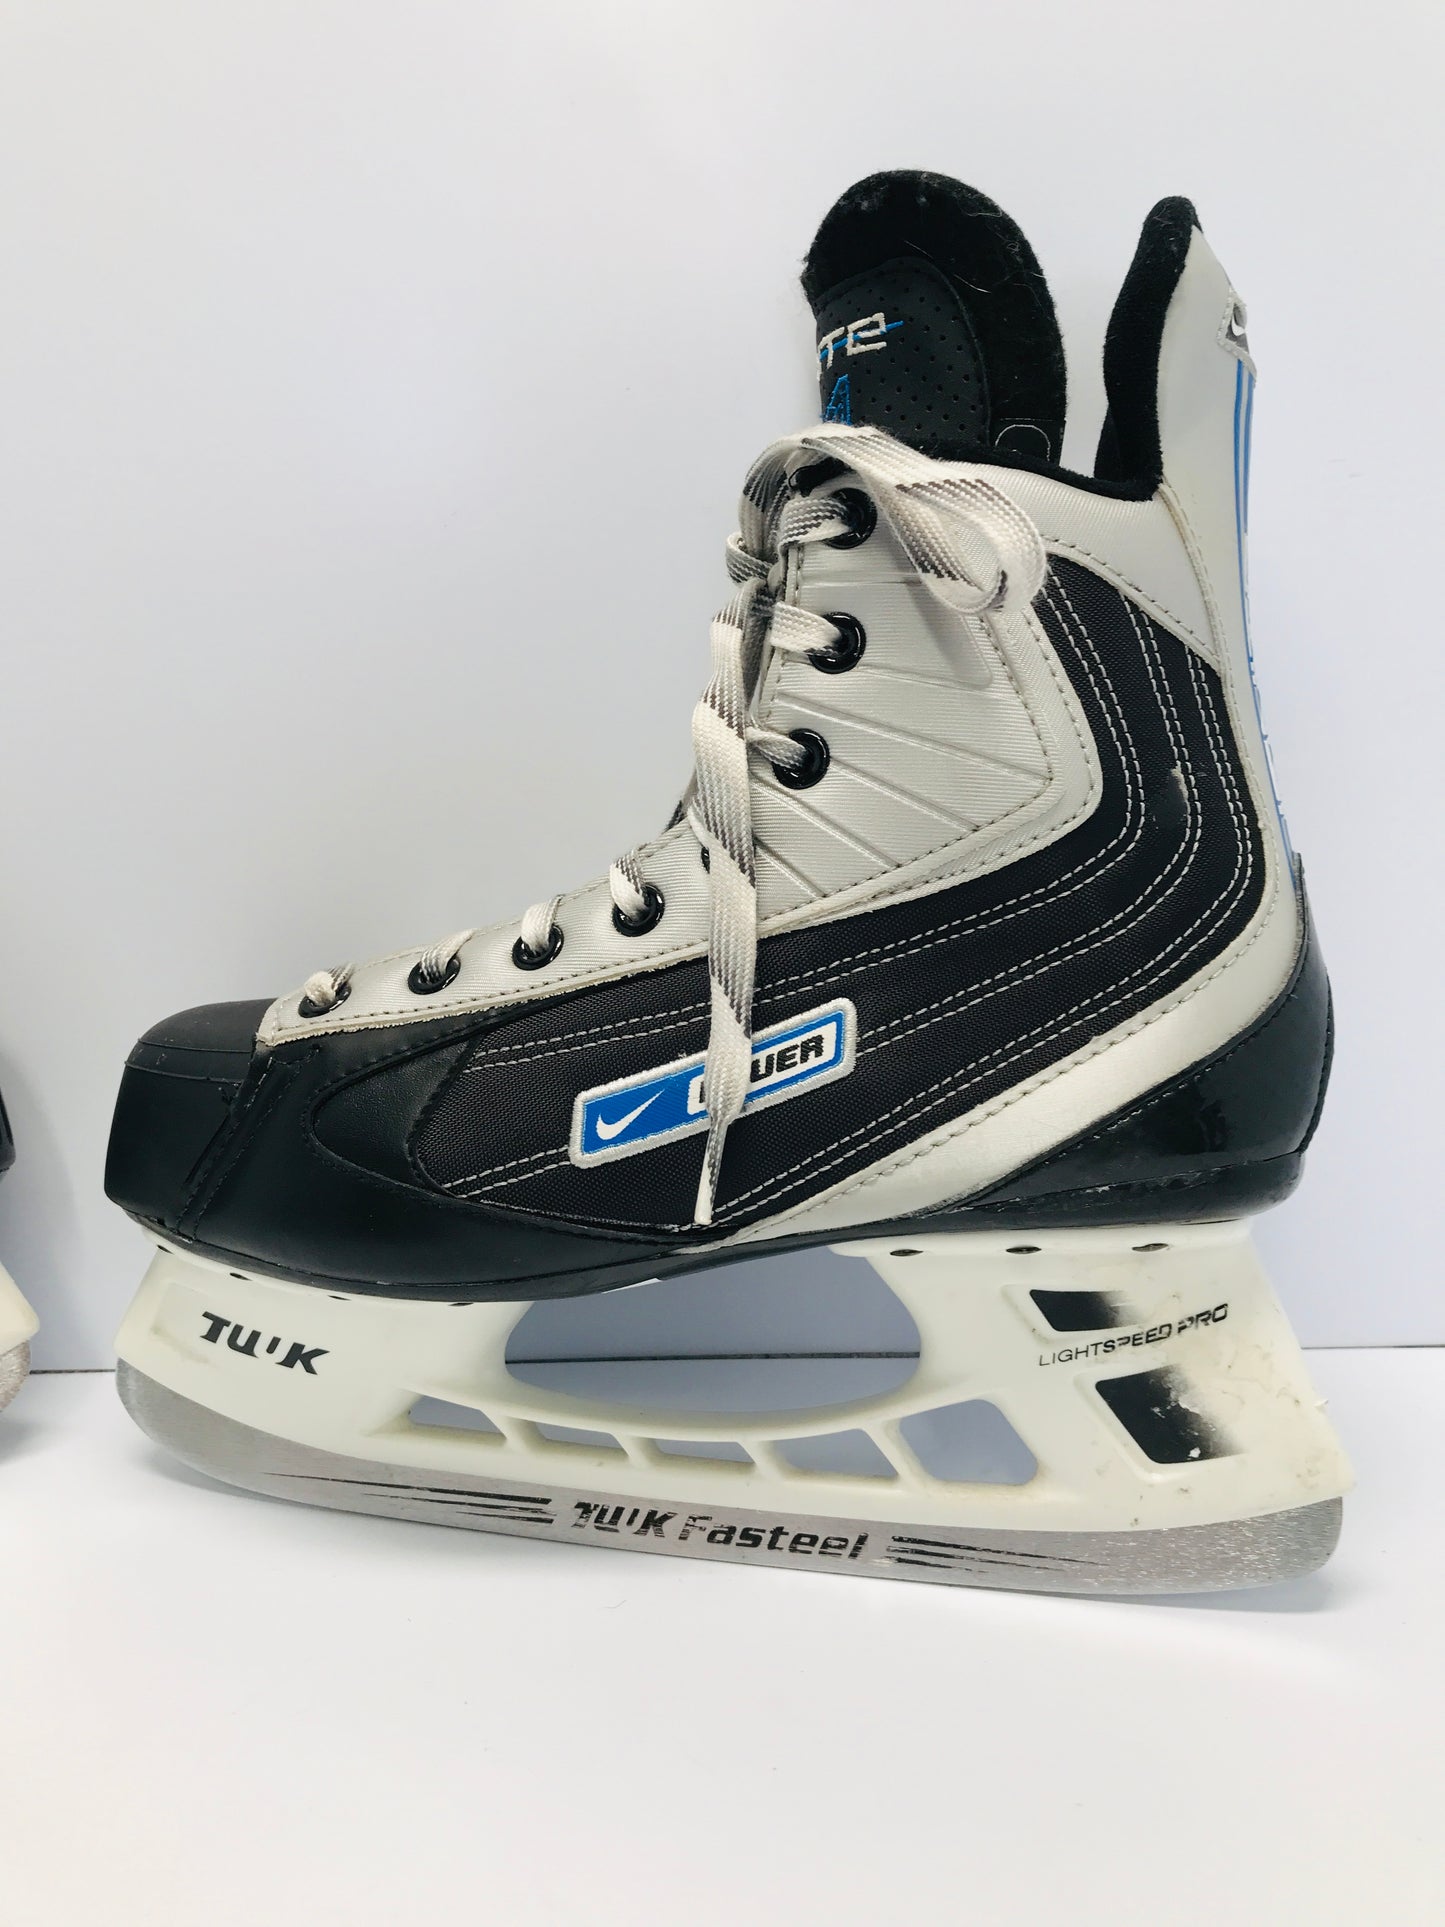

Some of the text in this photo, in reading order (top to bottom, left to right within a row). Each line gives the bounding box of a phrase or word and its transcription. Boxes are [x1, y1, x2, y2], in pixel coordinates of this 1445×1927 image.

[699, 1034, 824, 1104] UER
[1039, 1303, 1228, 1366] LIGHTSPEED PRO
[678, 1515, 869, 1559] Fasteel
